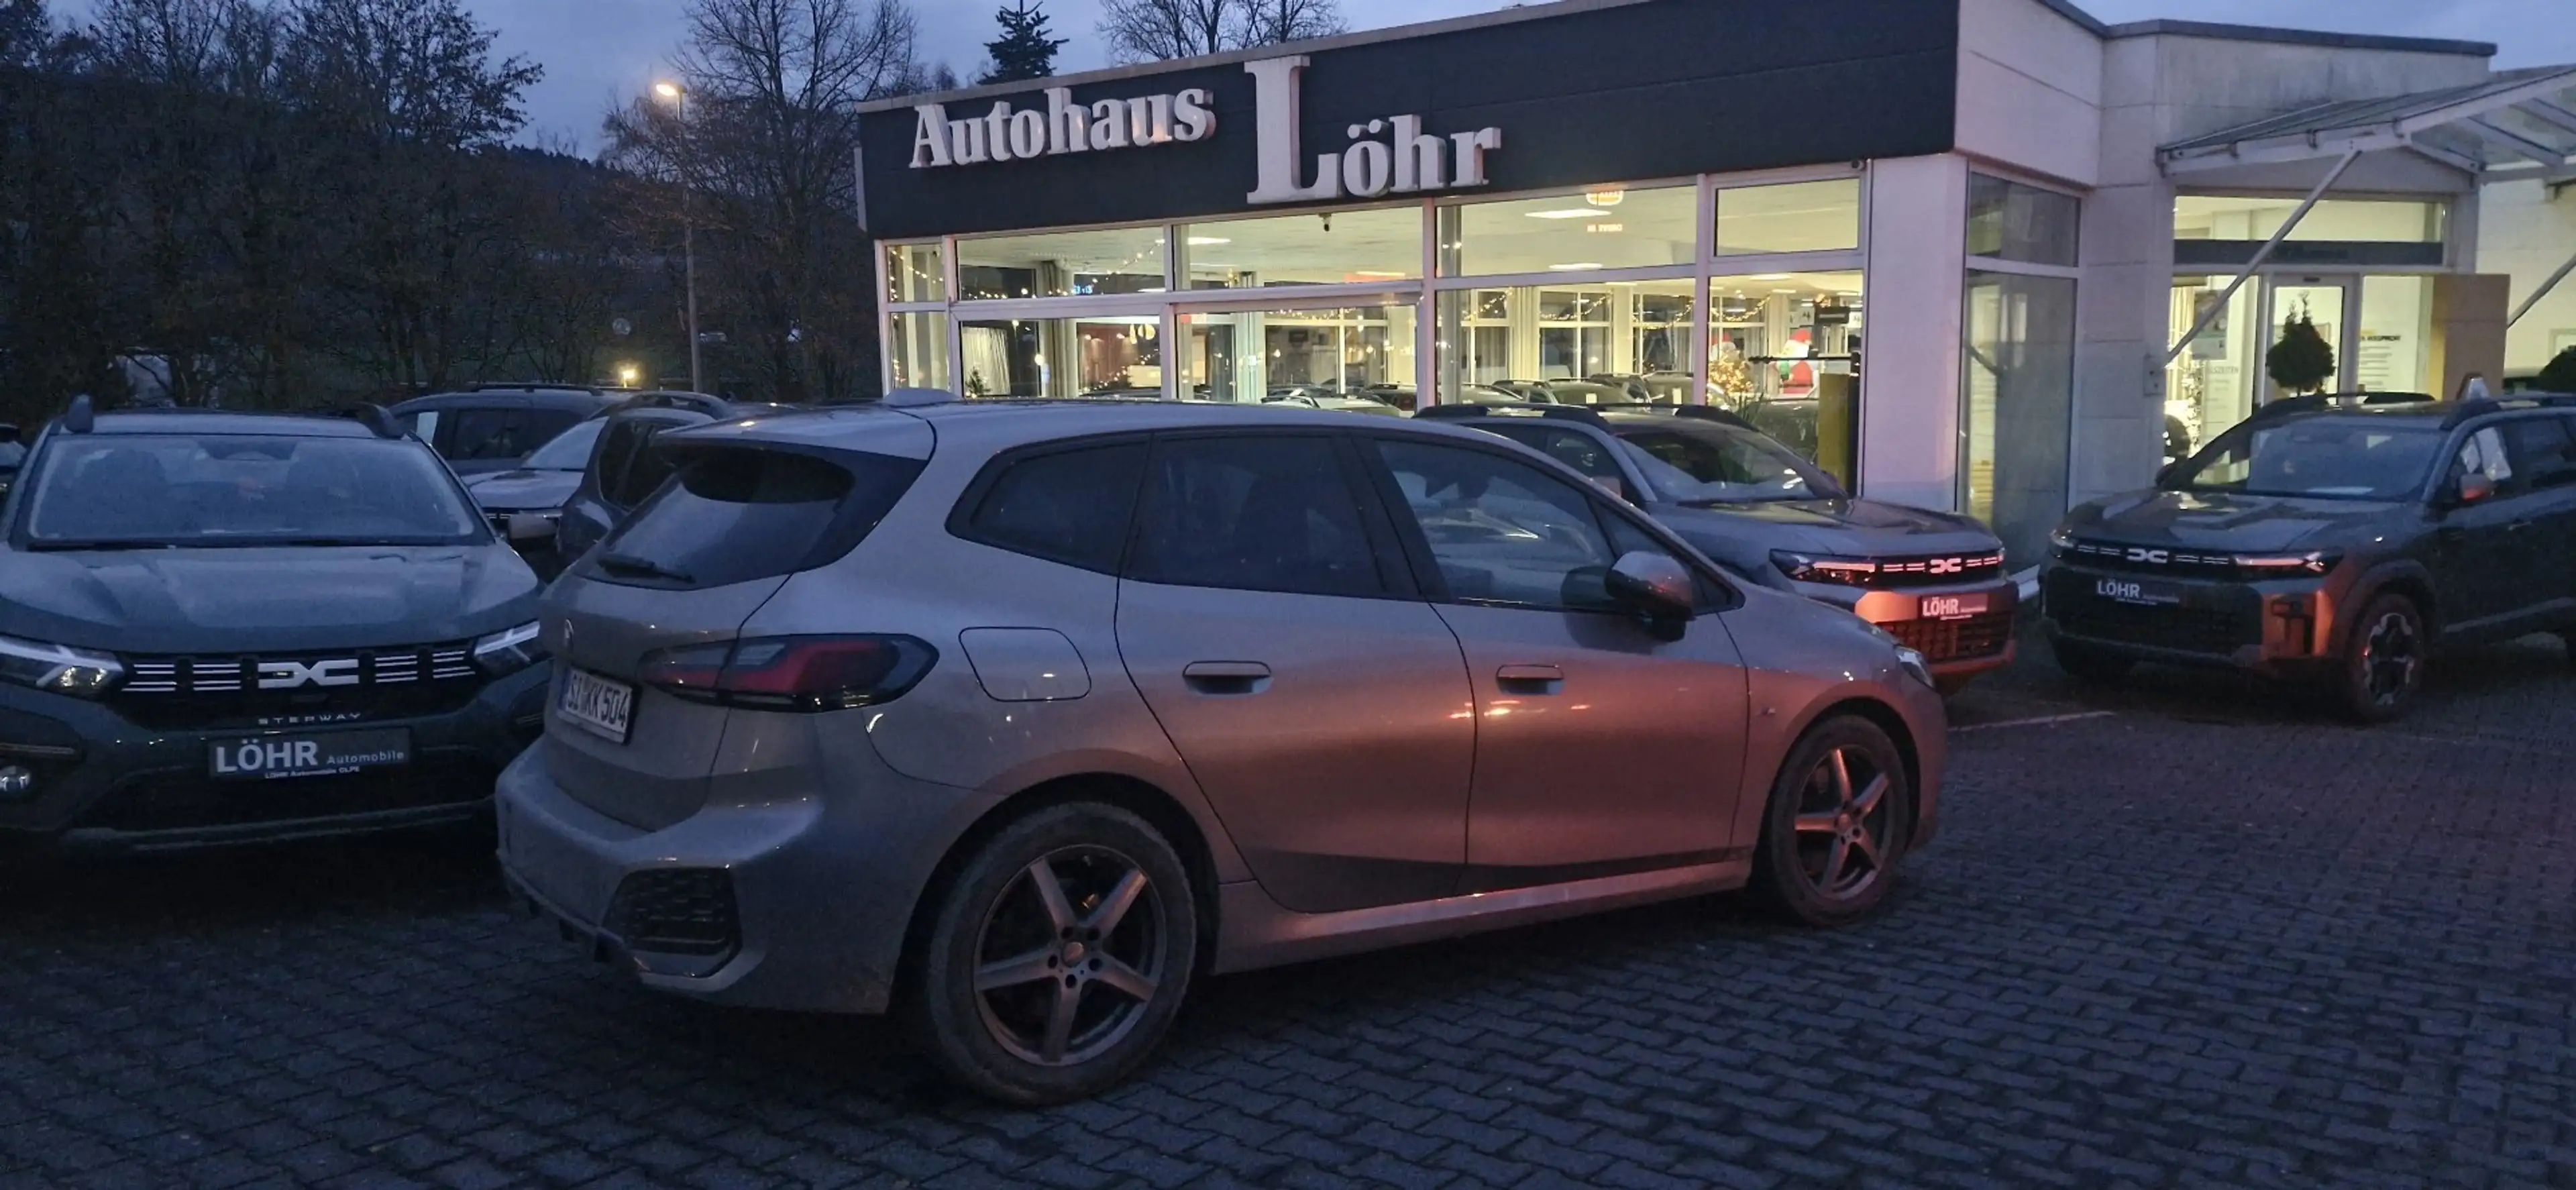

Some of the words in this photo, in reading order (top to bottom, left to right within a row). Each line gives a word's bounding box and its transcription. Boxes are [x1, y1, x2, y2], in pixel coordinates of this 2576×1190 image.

[909, 86, 1216, 168] Autohaus
[1244, 55, 1501, 204] Löhr
[2097, 578, 2141, 598] LÖHR
[1923, 596, 1959, 616] LÖHR
[258, 712, 361, 725] STEPWAY
[601, 686, 629, 728] 504
[216, 739, 319, 773] LÖHR
[327, 750, 405, 765] Automobile
